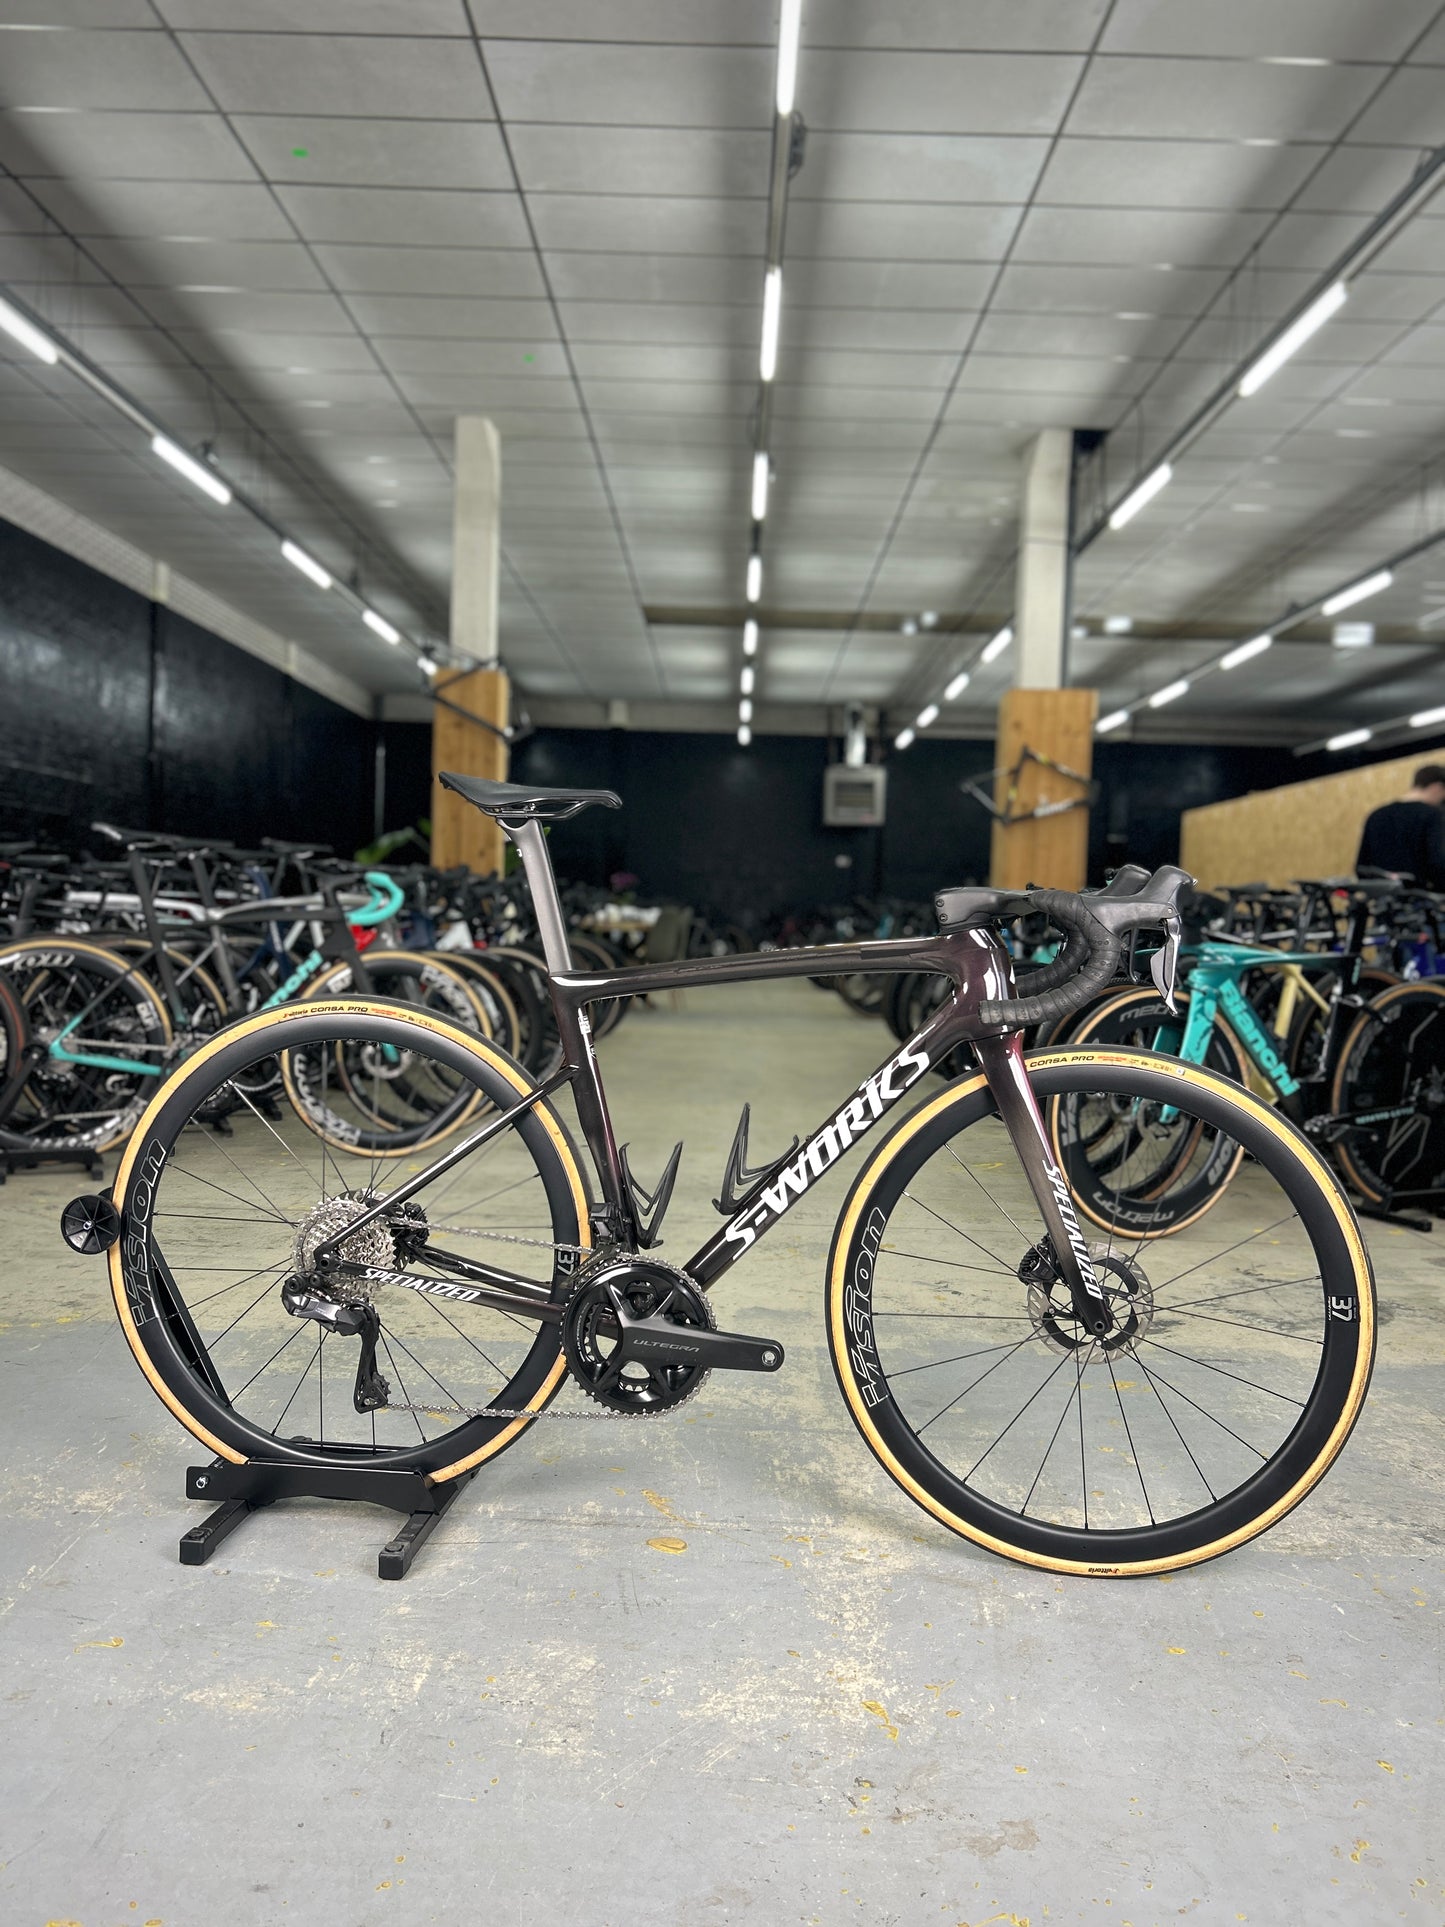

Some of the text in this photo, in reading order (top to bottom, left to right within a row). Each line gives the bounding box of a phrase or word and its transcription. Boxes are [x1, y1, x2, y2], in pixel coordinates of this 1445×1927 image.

[310, 1006, 345, 1014] CORSA
[347, 1006, 369, 1014] PRO
[1219, 979, 1301, 1097] Bianchi
[1029, 1057, 1068, 1069] CORSA
[1071, 1055, 1095, 1063] PRO
[725, 1026, 932, 1261] S-WORKS
[1042, 1159, 1104, 1301] SPECIALIZED
[557, 1250, 575, 1276] 37
[360, 1267, 481, 1302] SPECIALIZED
[1331, 1296, 1353, 1322] 37
[633, 1338, 700, 1353] ULTEGRA
